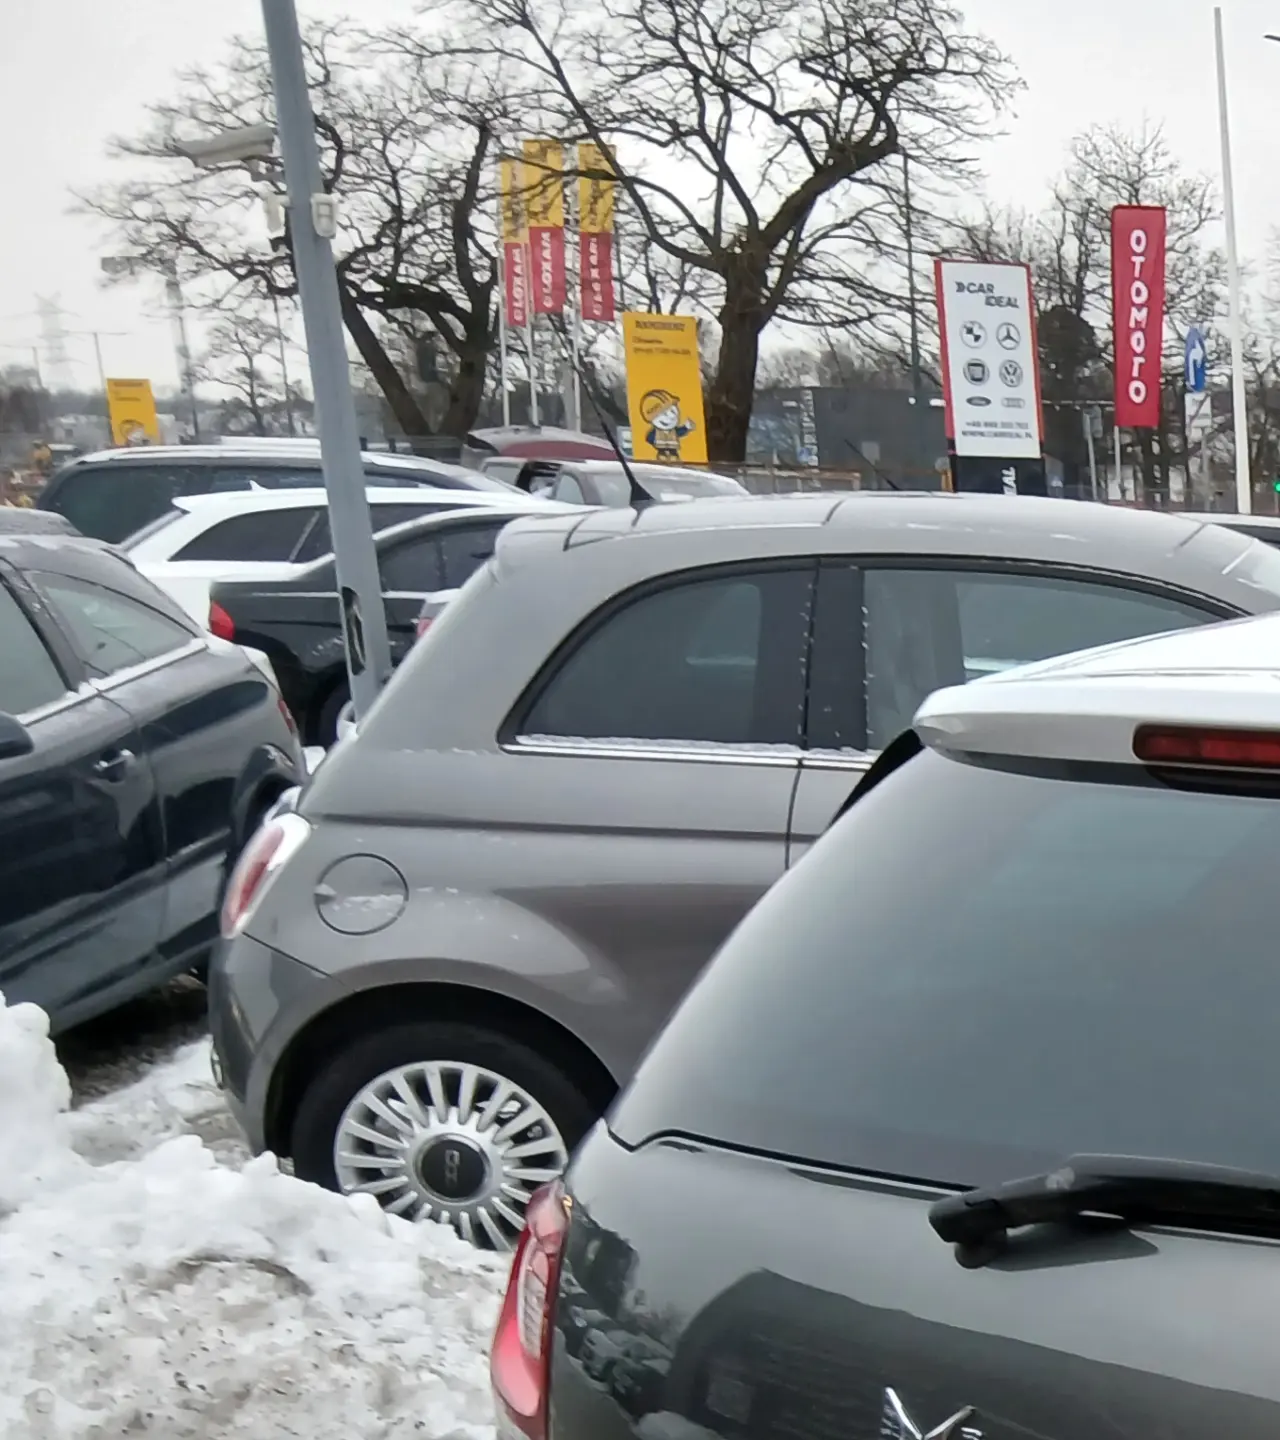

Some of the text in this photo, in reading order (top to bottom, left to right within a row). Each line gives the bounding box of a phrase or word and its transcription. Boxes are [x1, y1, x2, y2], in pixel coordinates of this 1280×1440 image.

[966, 282, 995, 293] CAR
[985, 295, 1019, 309] IDEAL
[1128, 229, 1149, 404] OTOMOTO
